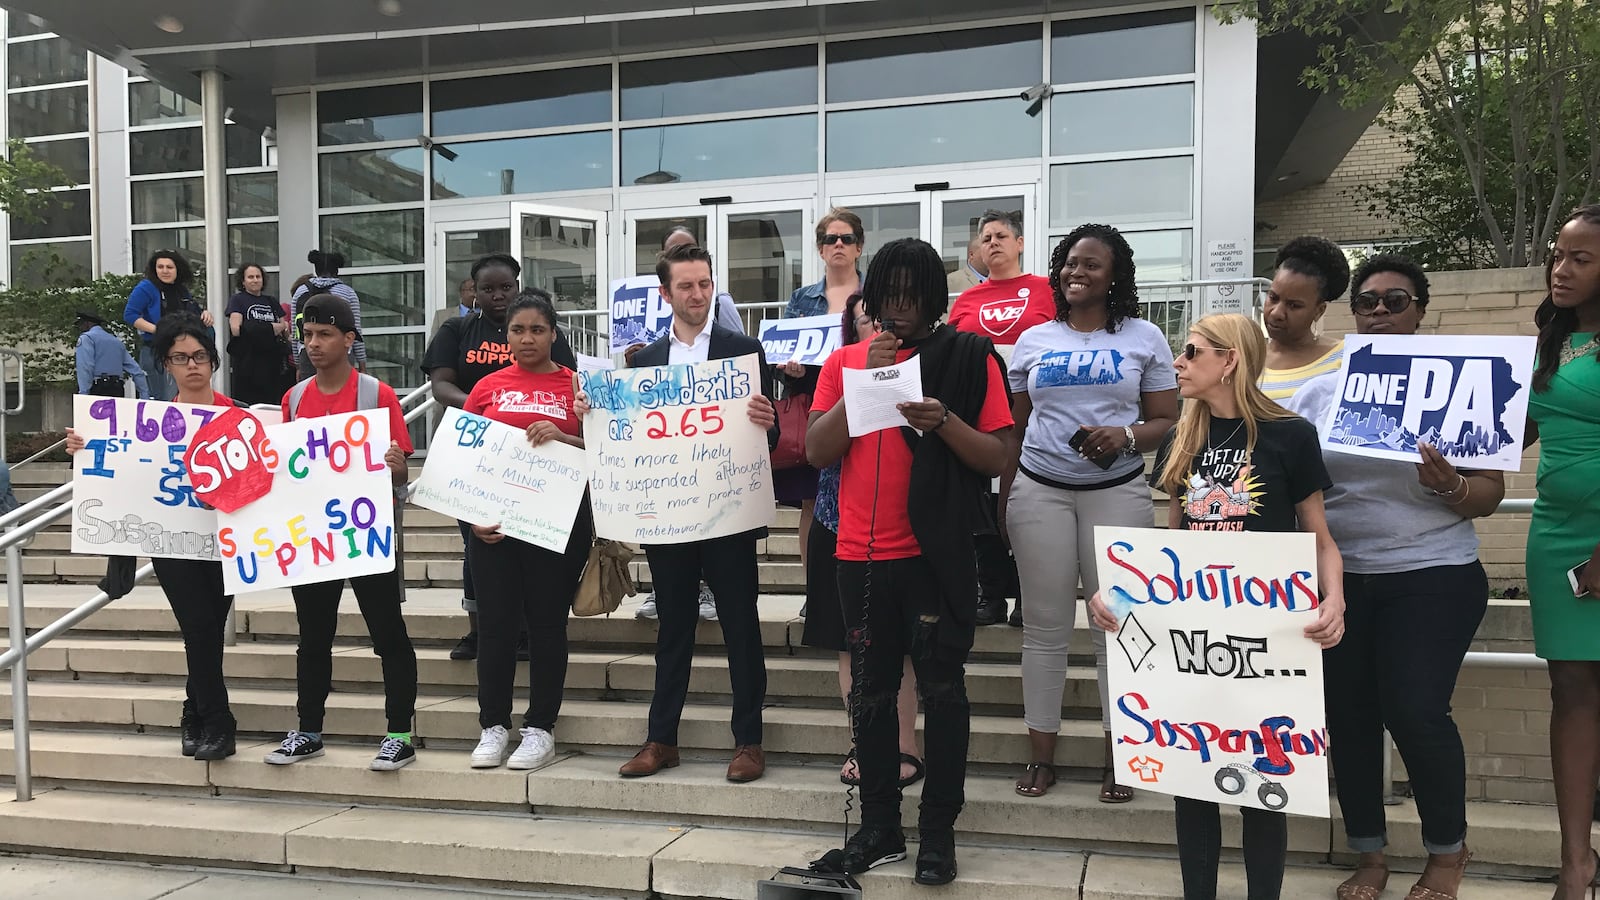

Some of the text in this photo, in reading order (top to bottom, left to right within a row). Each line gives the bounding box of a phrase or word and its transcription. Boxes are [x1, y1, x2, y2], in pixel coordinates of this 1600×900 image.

[613, 287, 674, 332] ONE P
[982, 306, 1025, 322] WE
[465, 350, 517, 365] SUPPO
[479, 341, 511, 353] ADU
[762, 339, 797, 354] ONE
[1040, 350, 1116, 380] ONE PA
[638, 360, 751, 409] Students
[1343, 357, 1496, 443] ONE PA
[89, 398, 216, 443] 9,607
[608, 405, 724, 441] are 2.65
[82, 438, 132, 479] 1ST
[189, 417, 258, 494] STOP
[258, 415, 385, 479] SCHOOL
[455, 416, 580, 482] 93% of suspensions
[598, 442, 732, 468] times more likely
[1201, 448, 1232, 467] LIFT
[502, 467, 547, 493] MINOR
[591, 455, 769, 498] to be suspended although
[1213, 464, 1241, 482] UP!
[449, 477, 520, 507] MISCONDUCT
[594, 479, 762, 516] they are not more prone to
[77, 498, 222, 559] SUSPENDE
[635, 522, 701, 538] misbehavior
[1216, 521, 1244, 531] PUSH
[1106, 540, 1319, 612] SOLUTIONS
[1117, 692, 1327, 776] SUSPENSION
